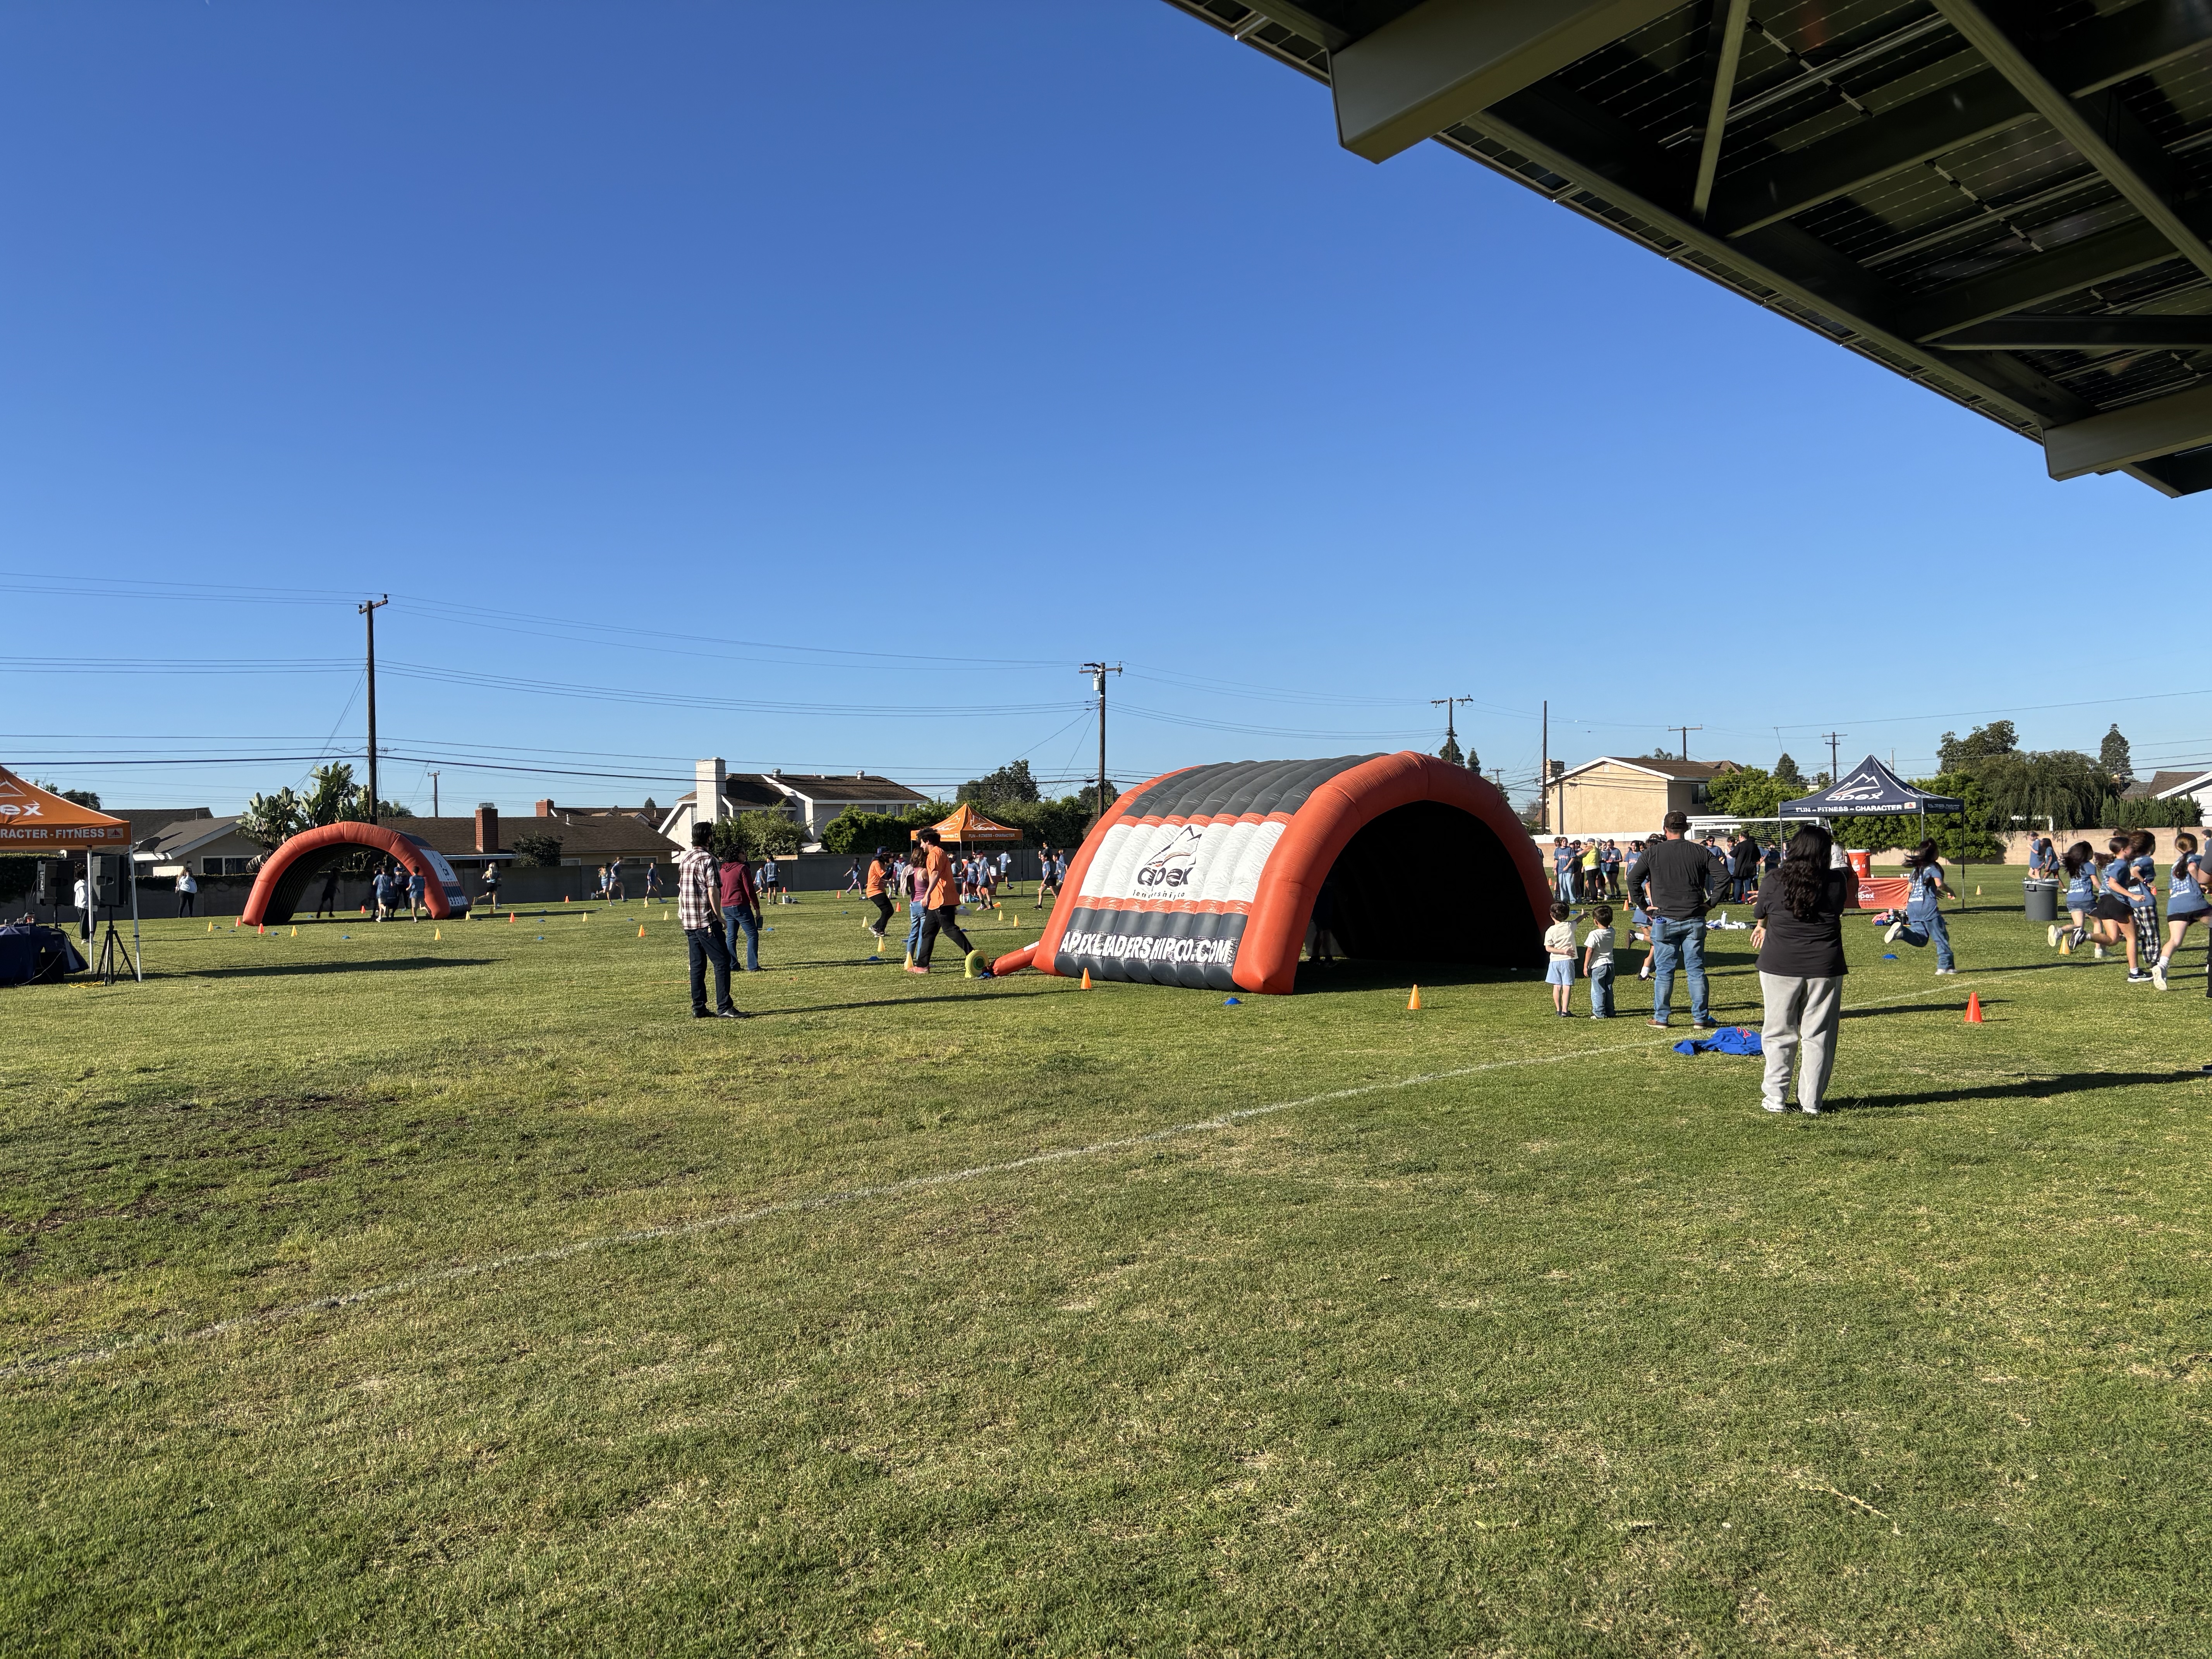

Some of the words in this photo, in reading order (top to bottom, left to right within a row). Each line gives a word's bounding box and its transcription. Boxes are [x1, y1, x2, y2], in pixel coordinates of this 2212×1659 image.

[1826, 791, 1884, 801] apex
[0, 829, 48, 838] RACTER
[55, 828, 105, 838] FITNESS
[1137, 867, 1194, 891] apex
